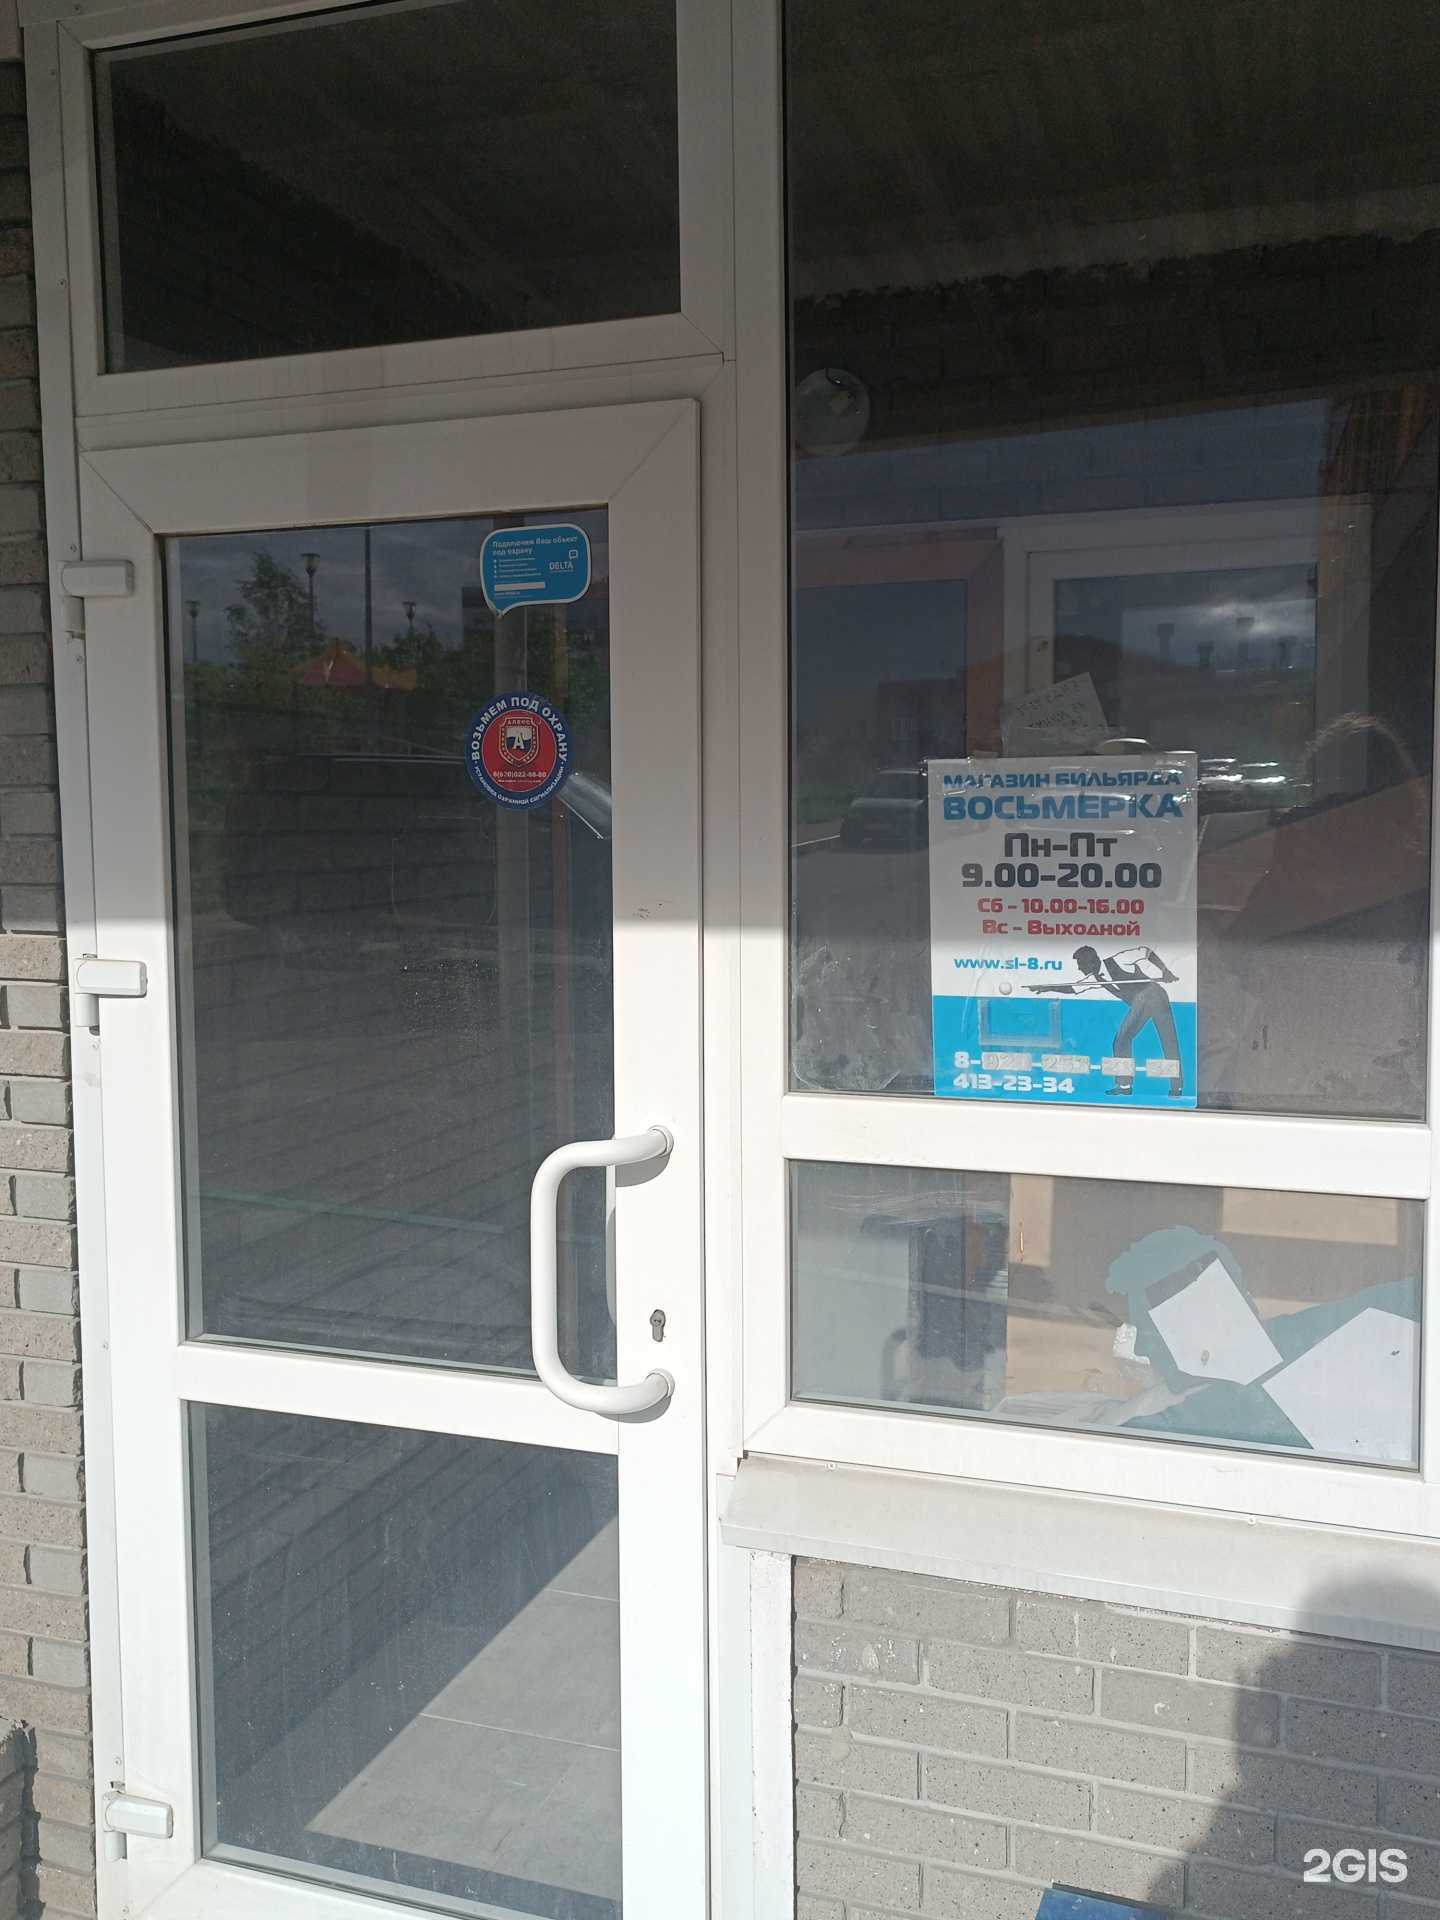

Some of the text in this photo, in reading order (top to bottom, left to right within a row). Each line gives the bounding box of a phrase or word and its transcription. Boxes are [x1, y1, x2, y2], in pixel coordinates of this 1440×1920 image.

[549, 561, 574, 570] DELTA
[471, 696, 568, 762] ВОЗЬМЕМ ПОД ОХРАНУ
[943, 770, 1182, 789] МАГАЗИН БИЛЬЯРДА
[943, 793, 1185, 821] ВОСЬМЕРКА
[1004, 832, 1118, 858] Пн-Пт
[961, 862, 1162, 888] 9.00-20.00
[977, 898, 1003, 914] Сб
[982, 919, 1008, 935] Вс
[1027, 918, 1141, 937] Выходной
[953, 1073, 1075, 1094] 413-23-34
